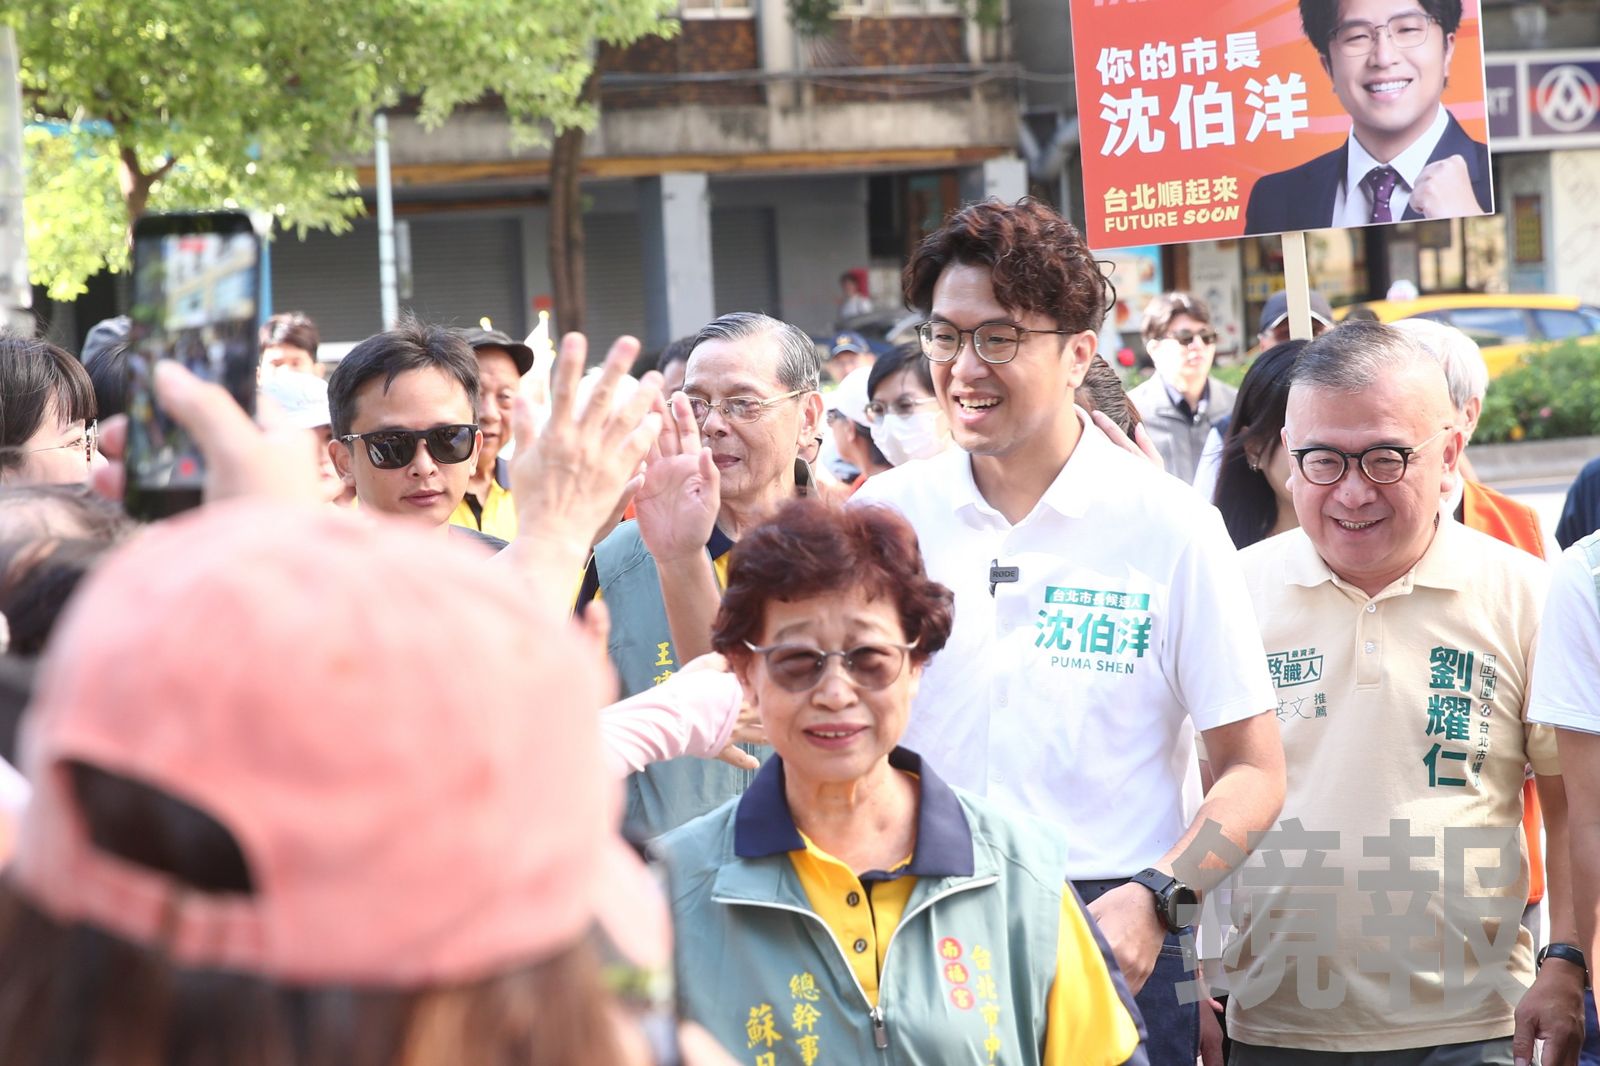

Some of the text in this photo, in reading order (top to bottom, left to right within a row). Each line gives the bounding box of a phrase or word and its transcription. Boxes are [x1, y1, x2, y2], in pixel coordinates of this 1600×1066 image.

[1095, 31, 1262, 86] 你的市長
[1098, 72, 1309, 157] 沈伯洋
[1103, 175, 1239, 214] 台北順起來
[1104, 205, 1240, 233] FUTURE SOON
[1052, 589, 1141, 609] 台北市長候選人
[1034, 609, 1152, 658] 沈伯洋
[1051, 656, 1134, 674] PUMA SHEN
[1314, 692, 1327, 718] 推薦
[1422, 645, 1475, 788] 劉耀仁
[789, 971, 822, 1066] 總幹事
[971, 943, 1001, 1066] 台北市中
